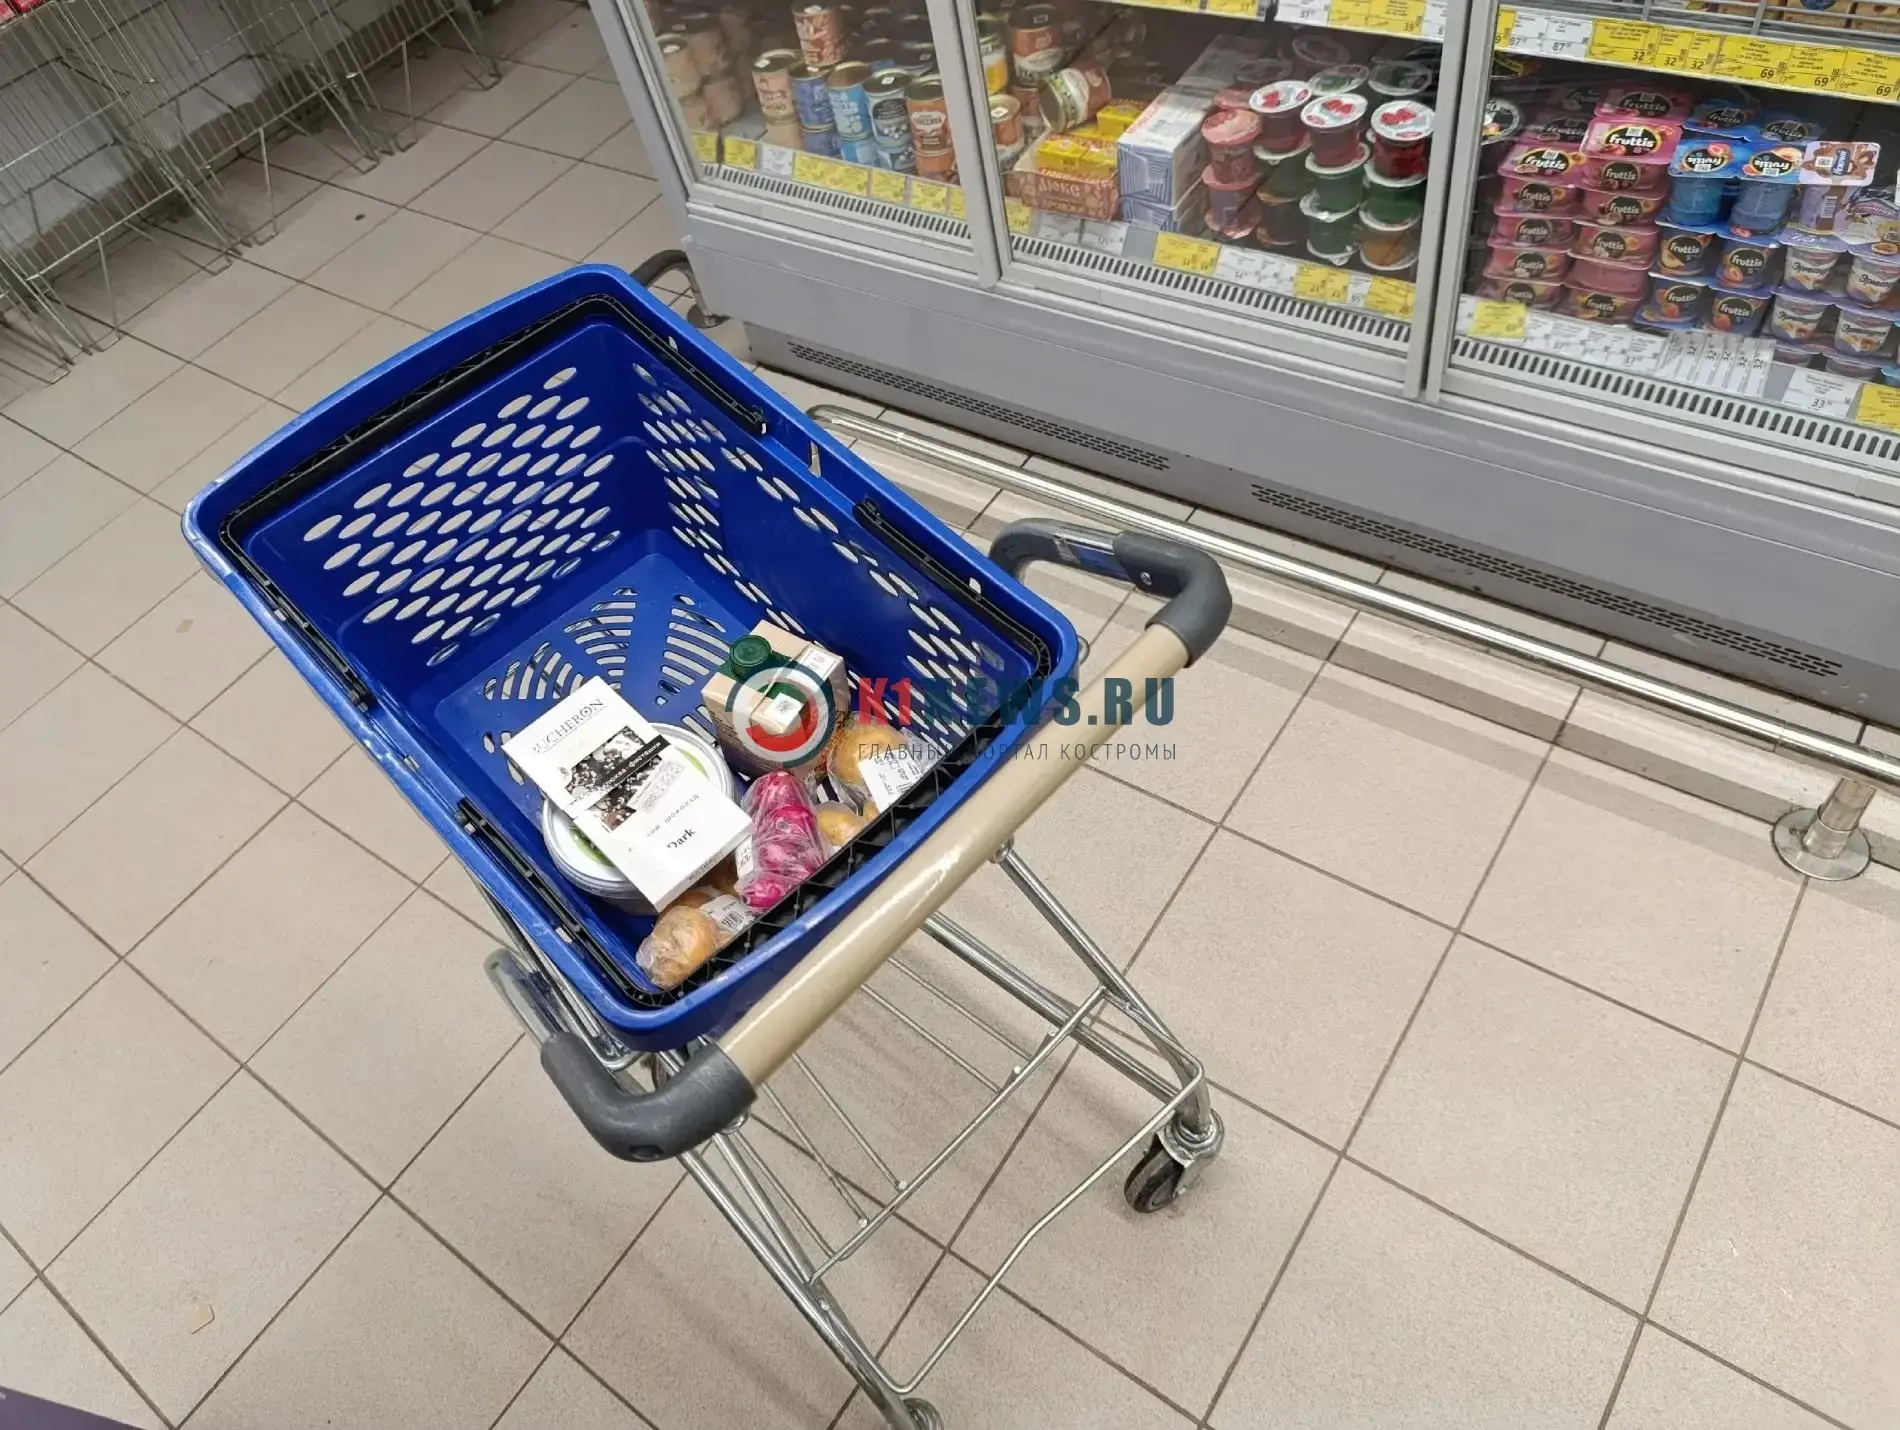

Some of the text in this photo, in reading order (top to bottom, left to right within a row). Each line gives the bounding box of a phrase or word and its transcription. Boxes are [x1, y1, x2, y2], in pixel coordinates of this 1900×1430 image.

[1632, 50, 1646, 61] 32
[1664, 56, 1677, 66] 32
[1690, 60, 1704, 70] 32
[1760, 68, 1774, 79] 69
[1814, 76, 1829, 87] 69
[1876, 85, 1891, 96] 69
[1811, 398, 1826, 409] 33
